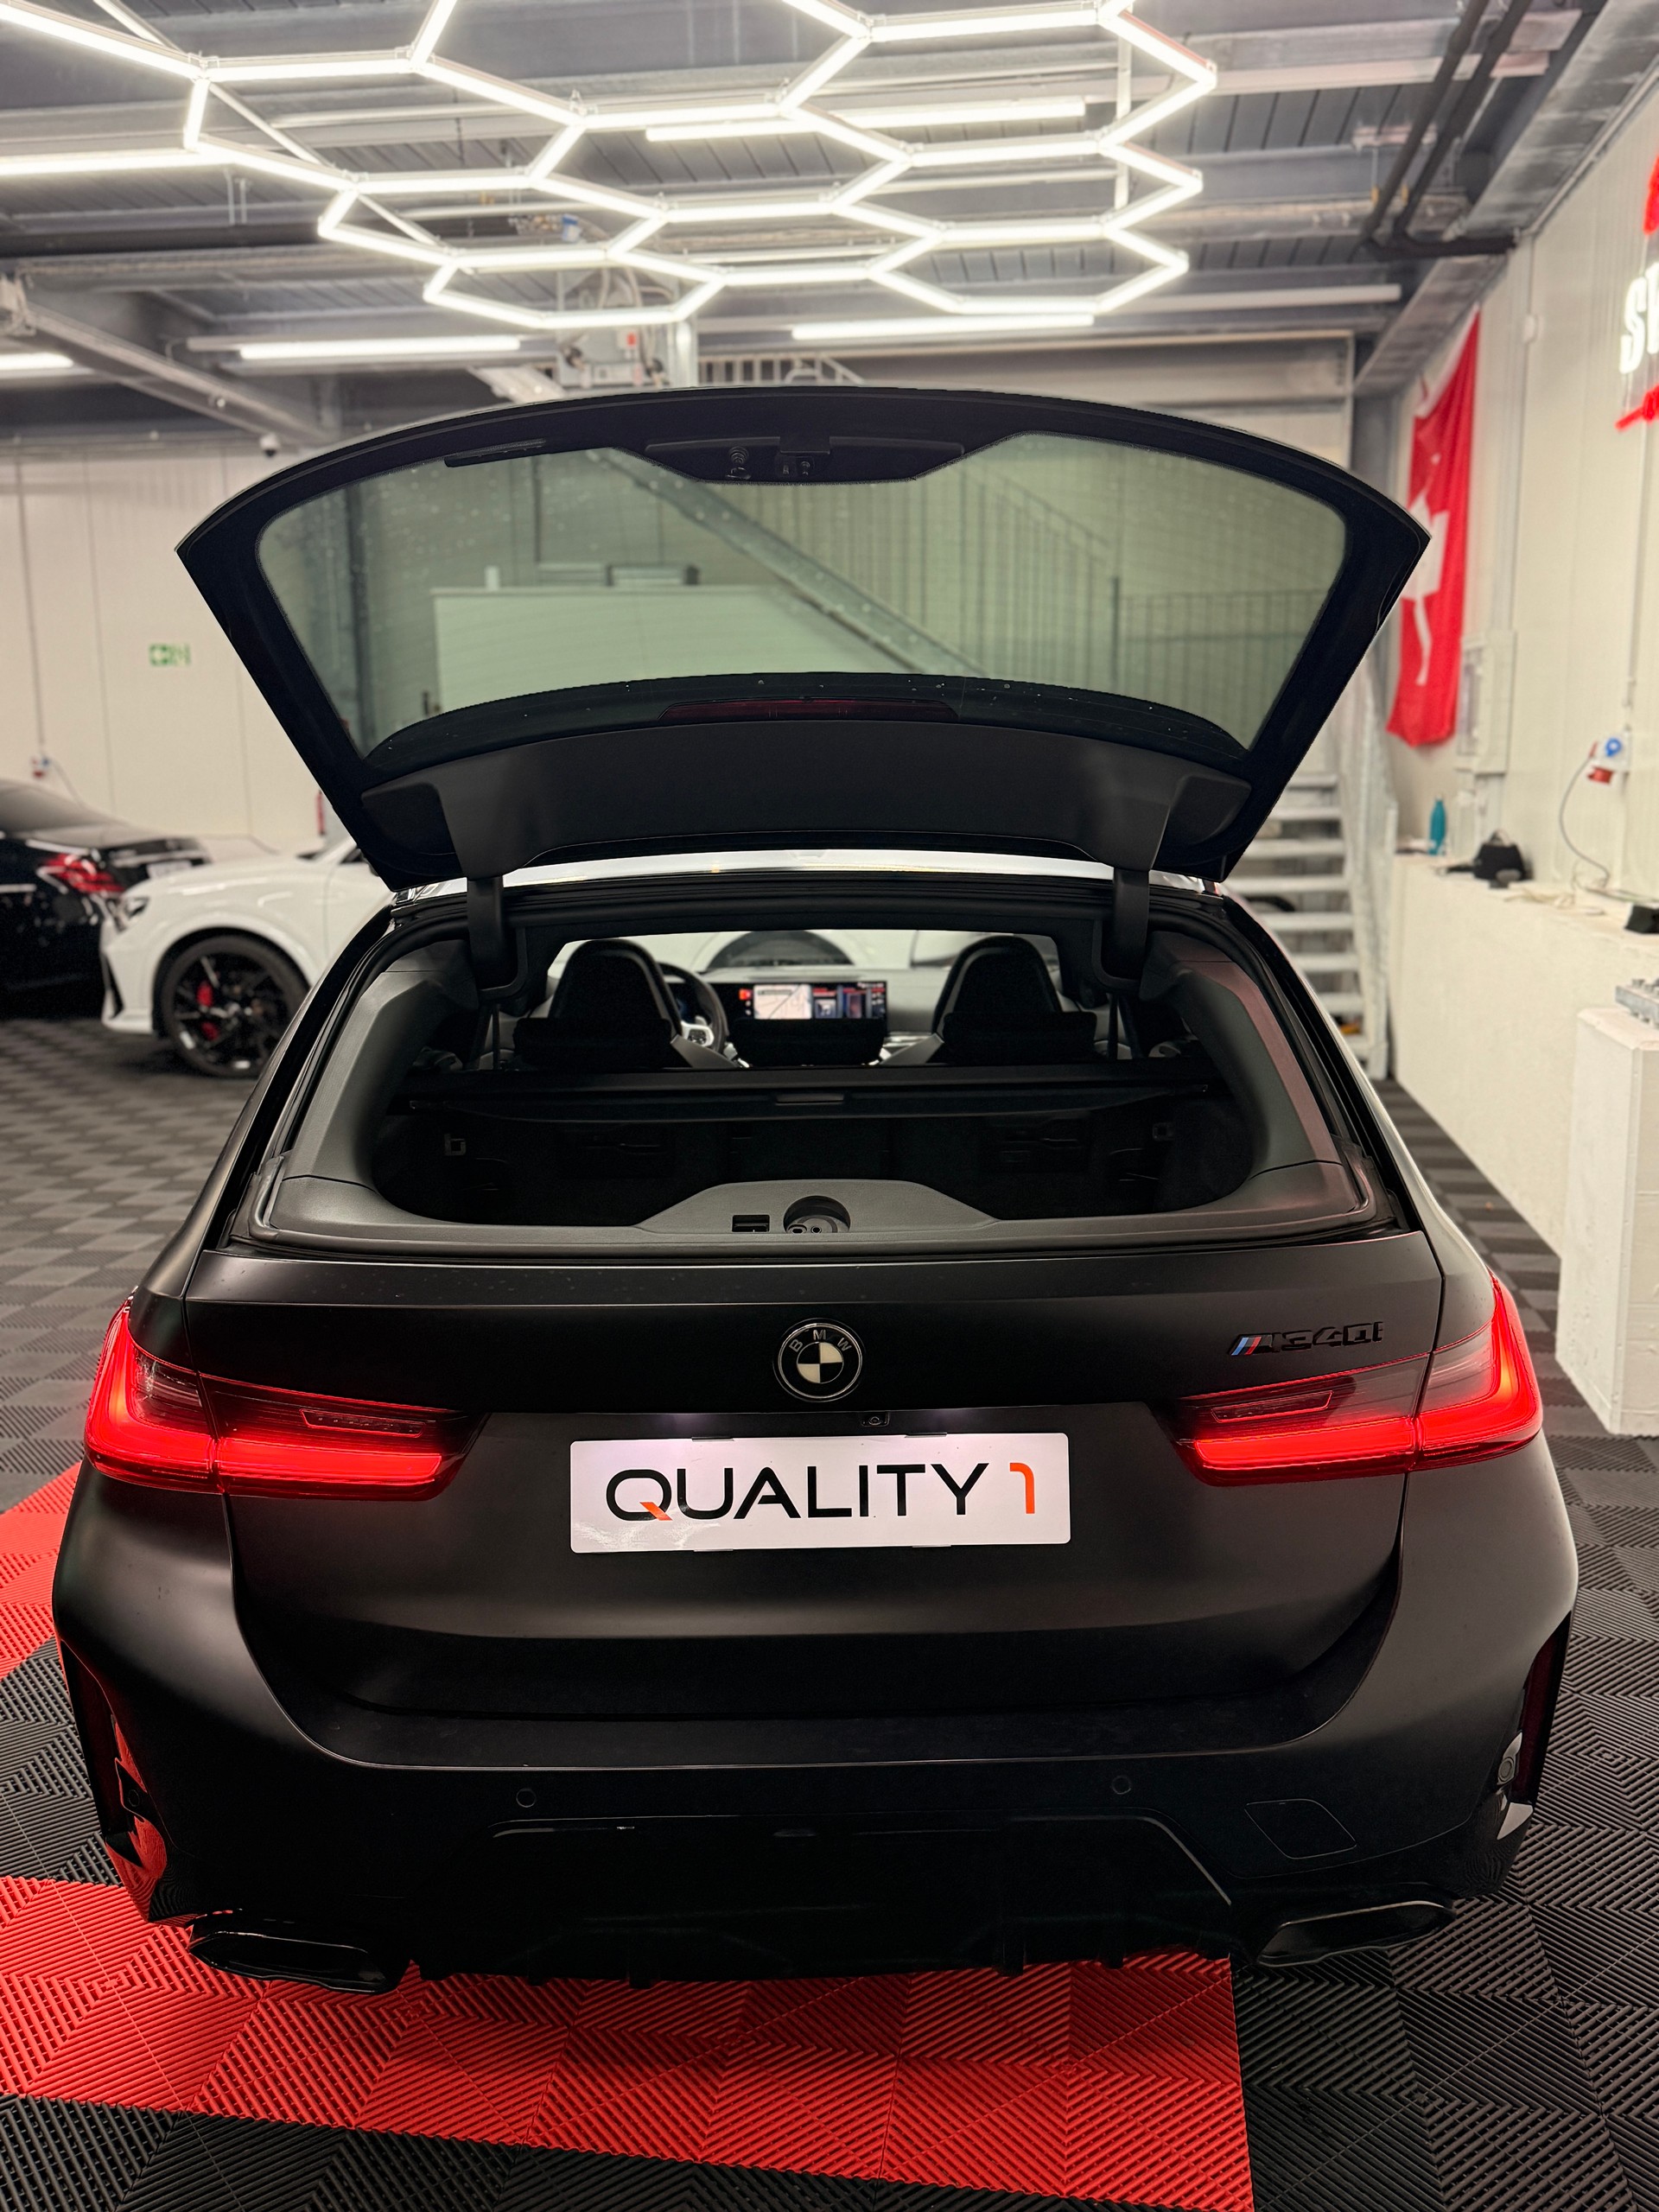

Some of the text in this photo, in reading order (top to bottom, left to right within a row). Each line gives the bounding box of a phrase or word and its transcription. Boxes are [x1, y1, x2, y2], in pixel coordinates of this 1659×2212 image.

[788, 1329, 853, 1353] BMW
[606, 1462, 1036, 1522] QUALITY 1
